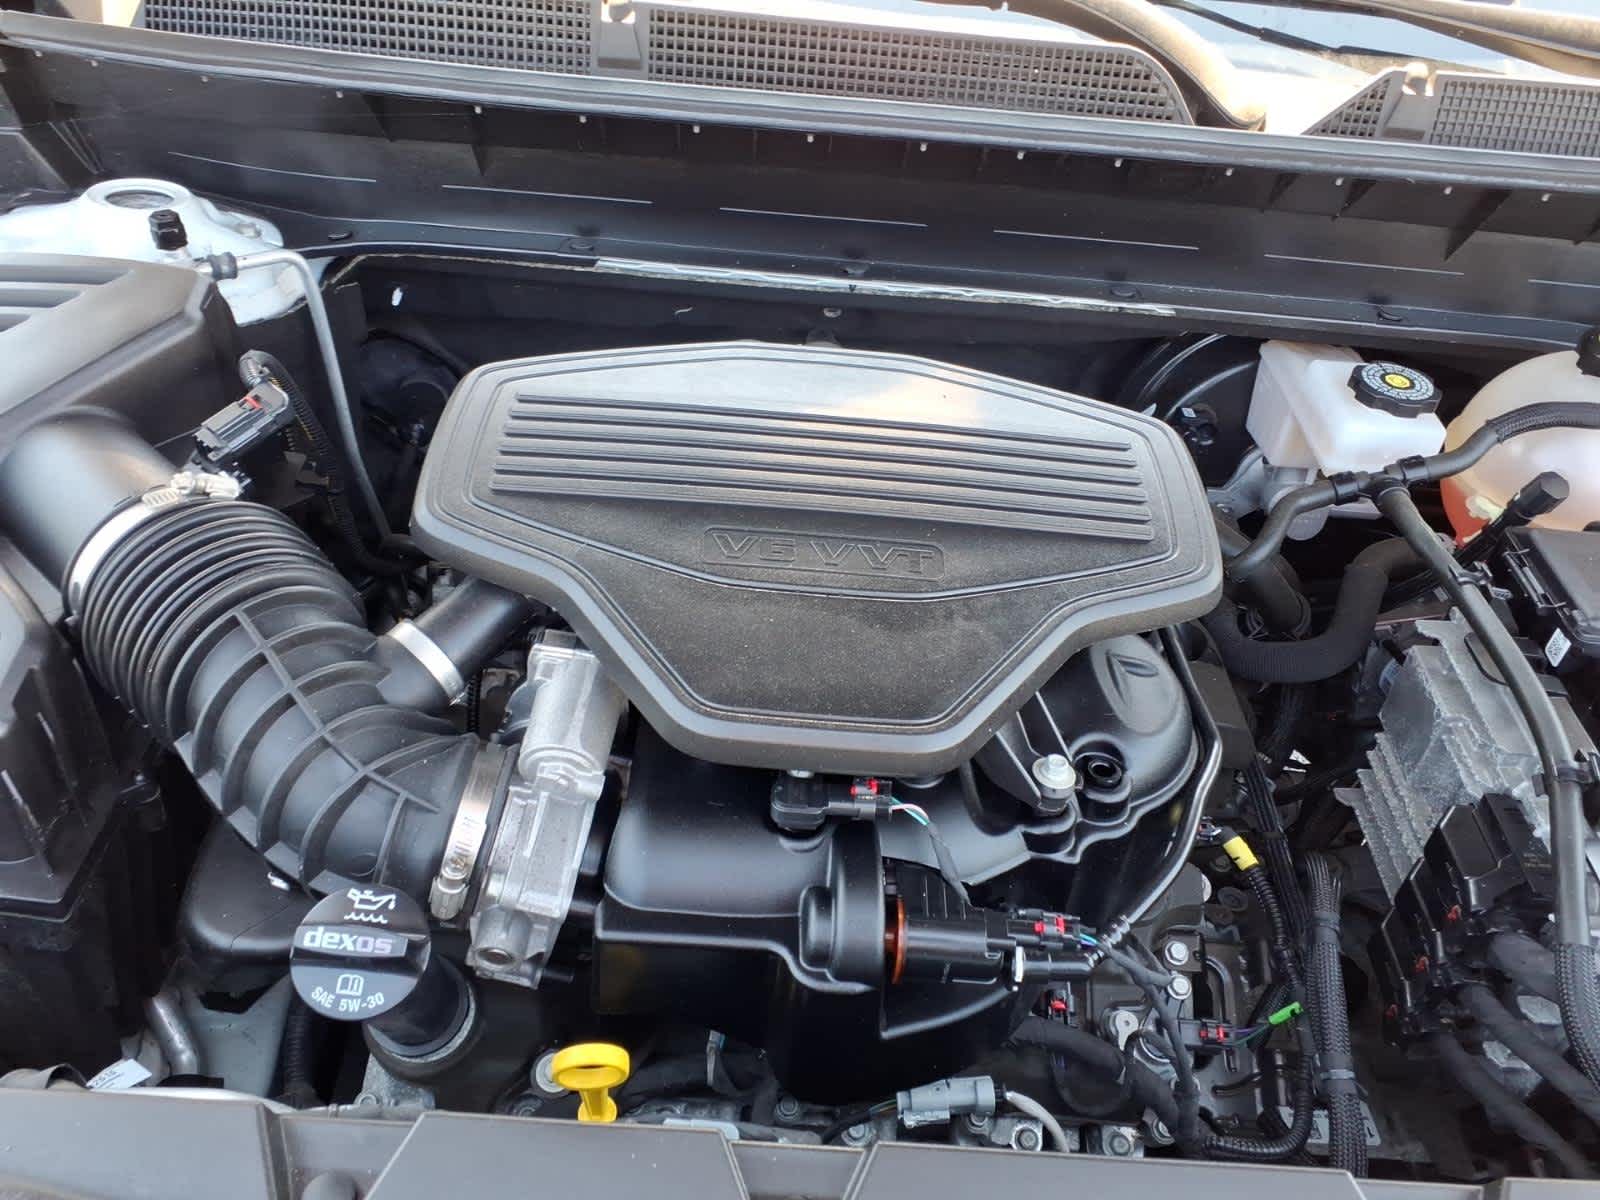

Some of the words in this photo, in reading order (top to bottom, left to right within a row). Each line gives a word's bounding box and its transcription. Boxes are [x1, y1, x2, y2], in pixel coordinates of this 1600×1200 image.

[712, 533, 797, 562] V6
[810, 541, 935, 574] VVT
[303, 926, 393, 954] dexos
[312, 986, 335, 1008] SAE
[338, 992, 385, 1012] 5W-30
